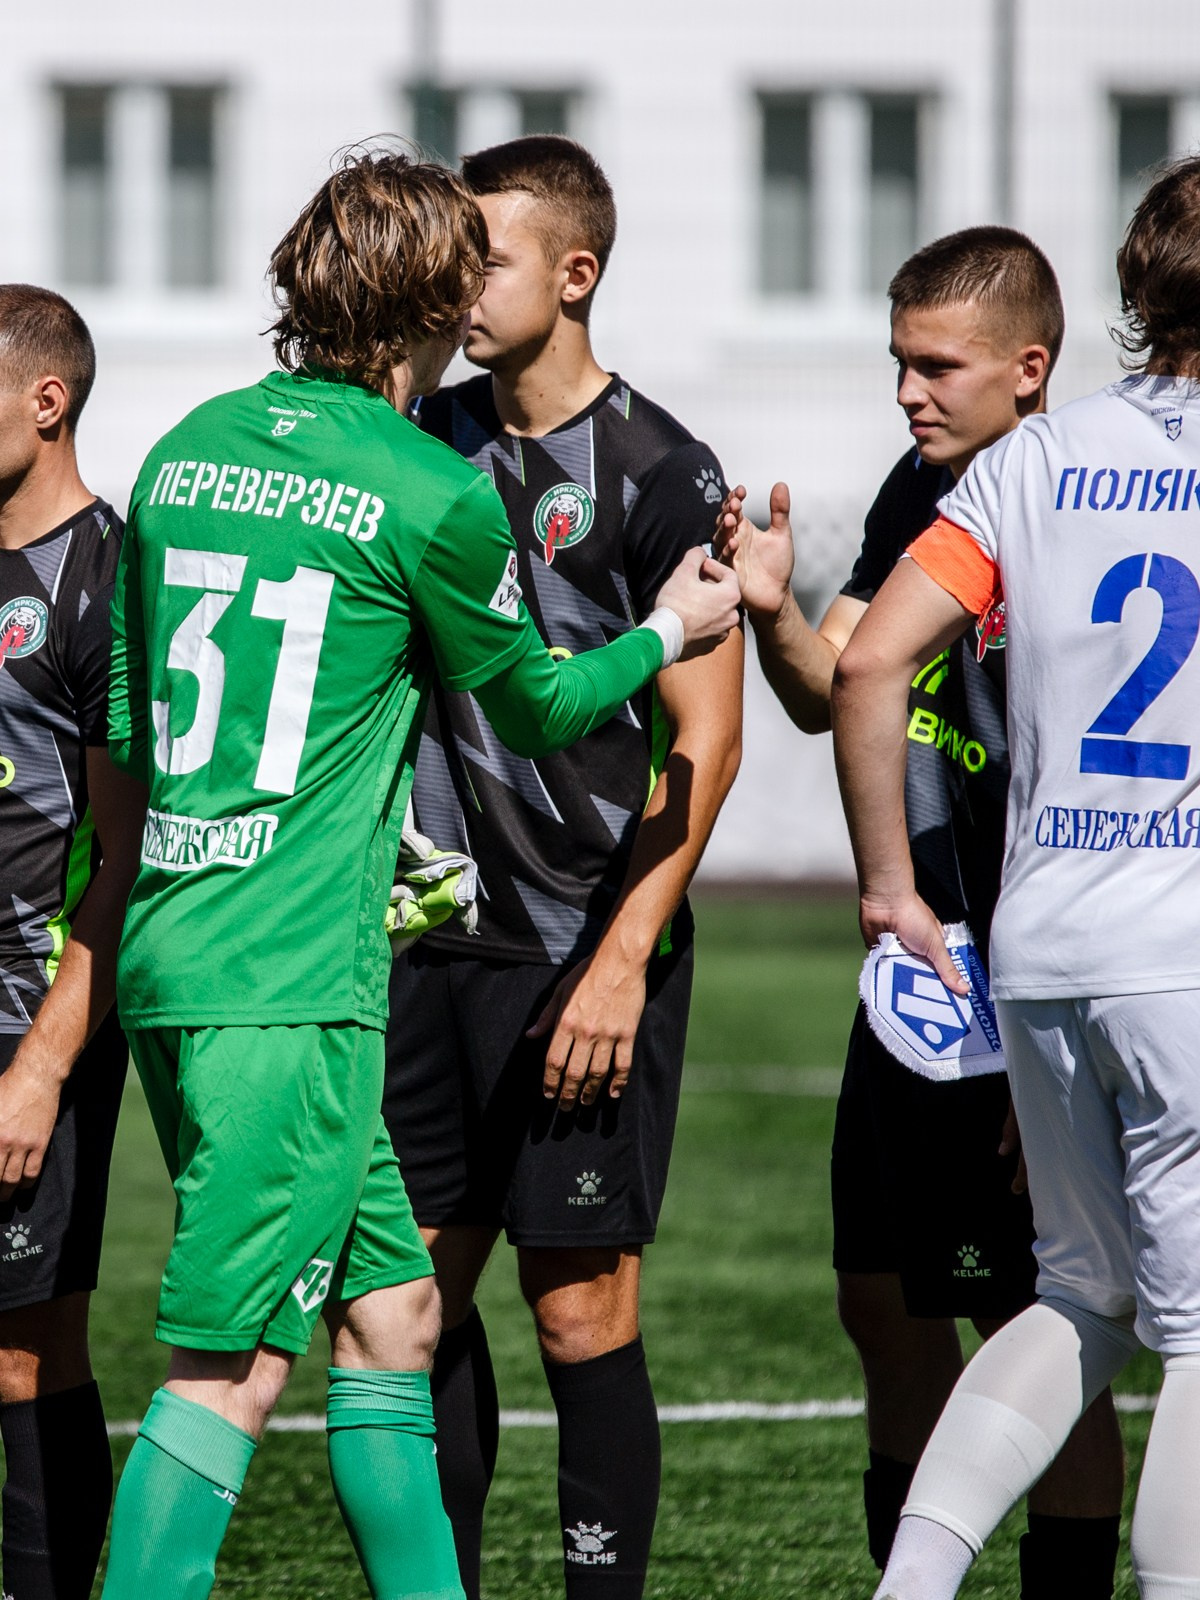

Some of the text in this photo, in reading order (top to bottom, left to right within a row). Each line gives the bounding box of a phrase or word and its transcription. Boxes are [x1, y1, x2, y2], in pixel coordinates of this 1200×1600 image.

[149, 460, 386, 543] ПЕРЕВЕРЗЕВ
[553, 486, 587, 501] ИРКУТСК
[14, 599, 46, 617] ИРКУТСК
[151, 547, 336, 796] 31
[567, 1196, 607, 1206] KELME
[2, 1244, 44, 1262] KELME
[952, 1268, 992, 1278] KELME
